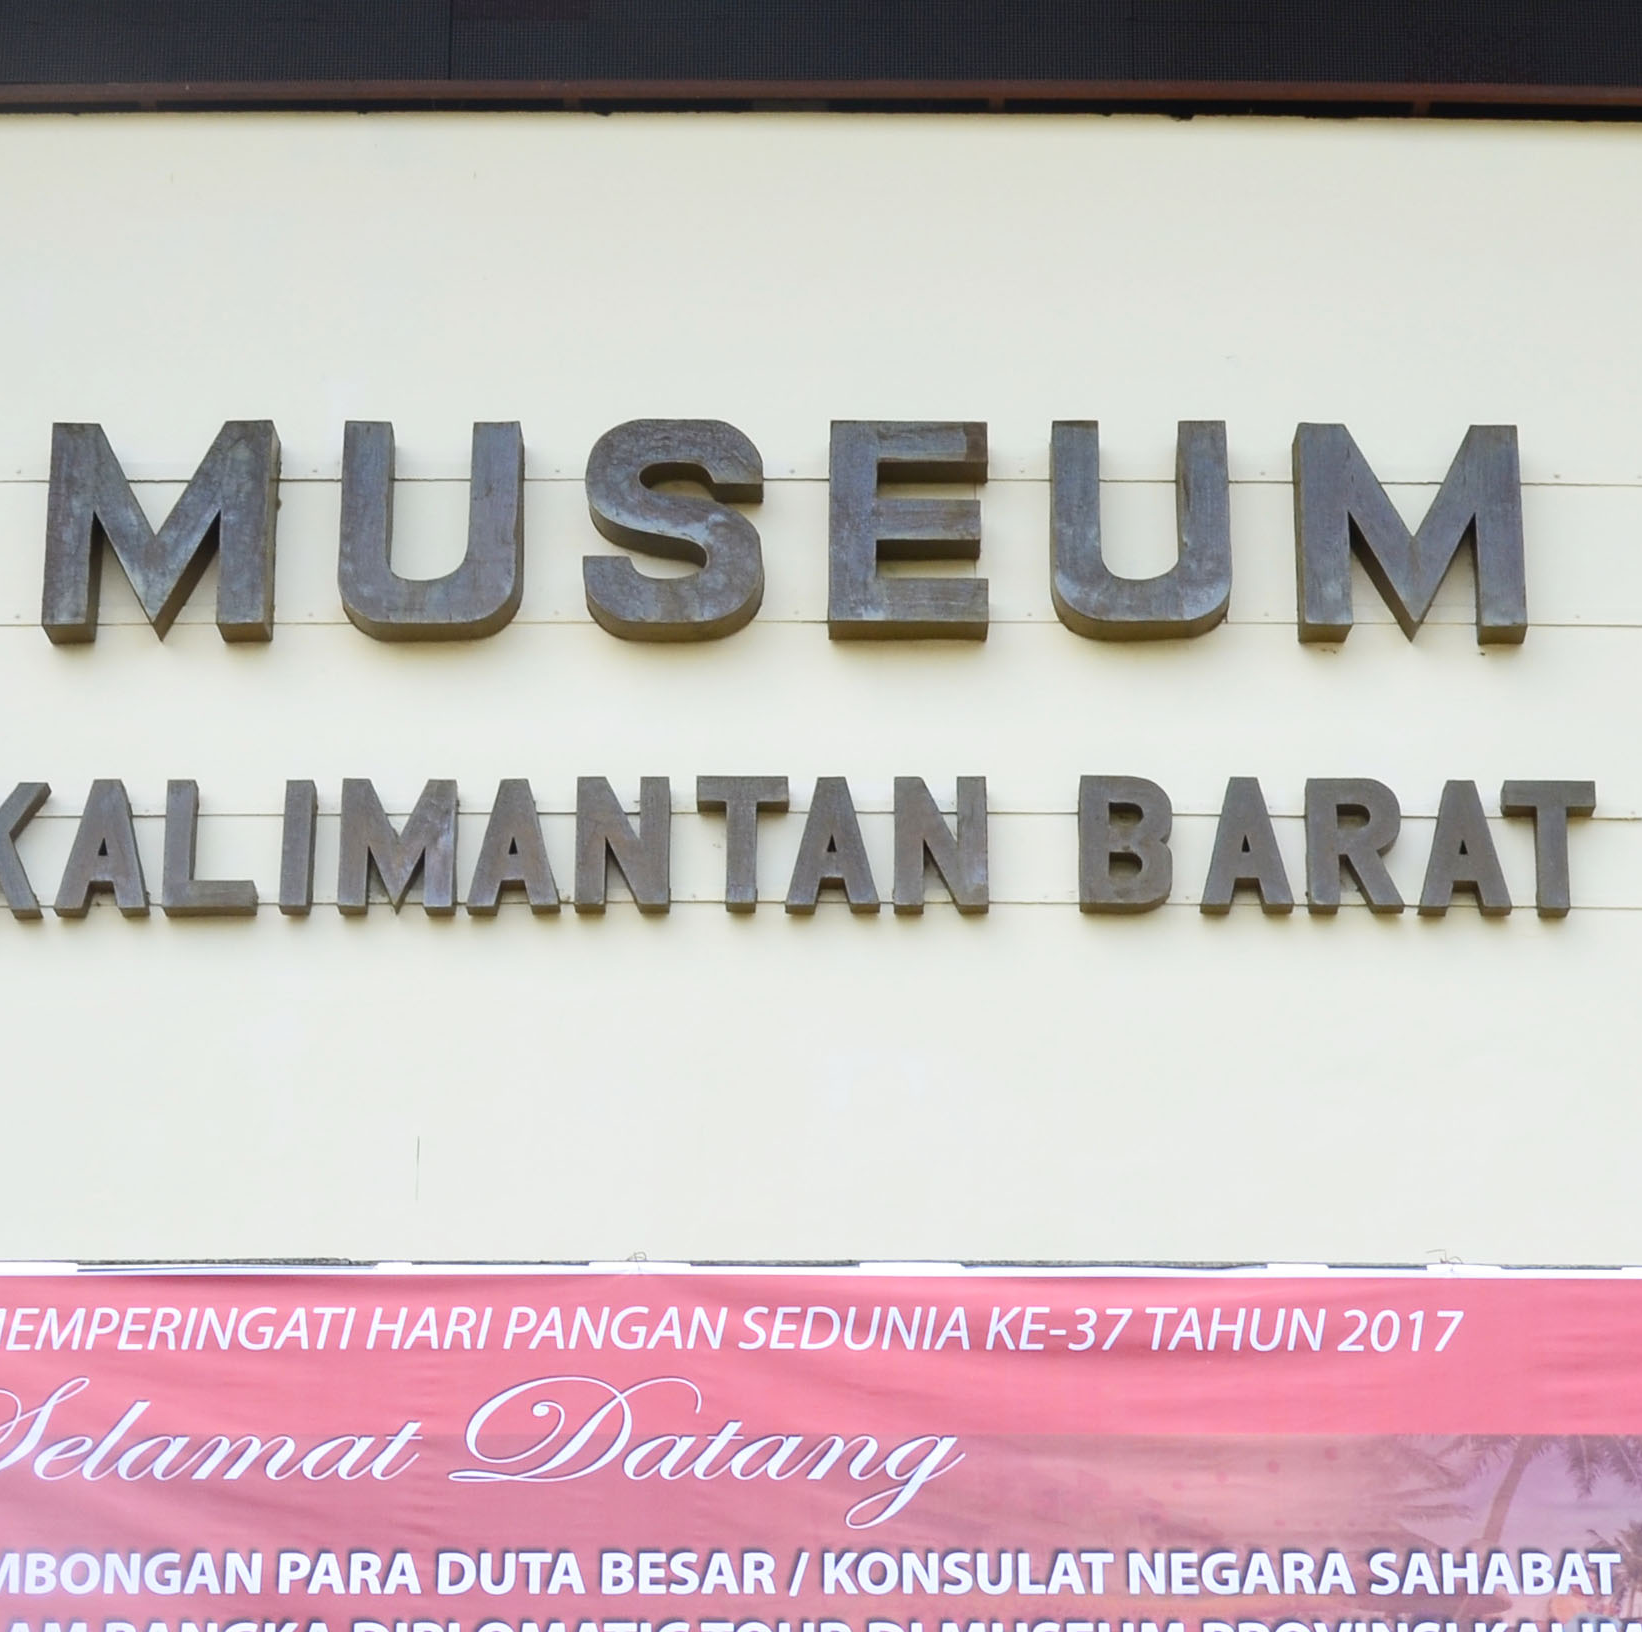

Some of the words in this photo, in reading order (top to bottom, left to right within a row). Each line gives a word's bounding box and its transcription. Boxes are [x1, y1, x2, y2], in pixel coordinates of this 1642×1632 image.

[41, 418, 1527, 645] MUSEUM
[1077, 776, 1596, 920] BARAT
[366, 1306, 493, 1350] HARI
[503, 1305, 728, 1351] PANGAN
[737, 1306, 969, 1351] SEDUNIA
[985, 1307, 1133, 1351] KE-37
[1145, 1307, 1326, 1352] TAHUN
[1337, 1309, 1464, 1353] 2017
[448, 1375, 966, 1530] Datang
[278, 1552, 422, 1596] PARA
[437, 1552, 586, 1596] DUTA
[601, 1552, 777, 1596] BESAR
[788, 1552, 810, 1597] /
[823, 1552, 1115, 1596] KONSULAT
[1128, 1552, 1356, 1596] NEGARA
[1369, 1553, 1621, 1596] SAHABAT
